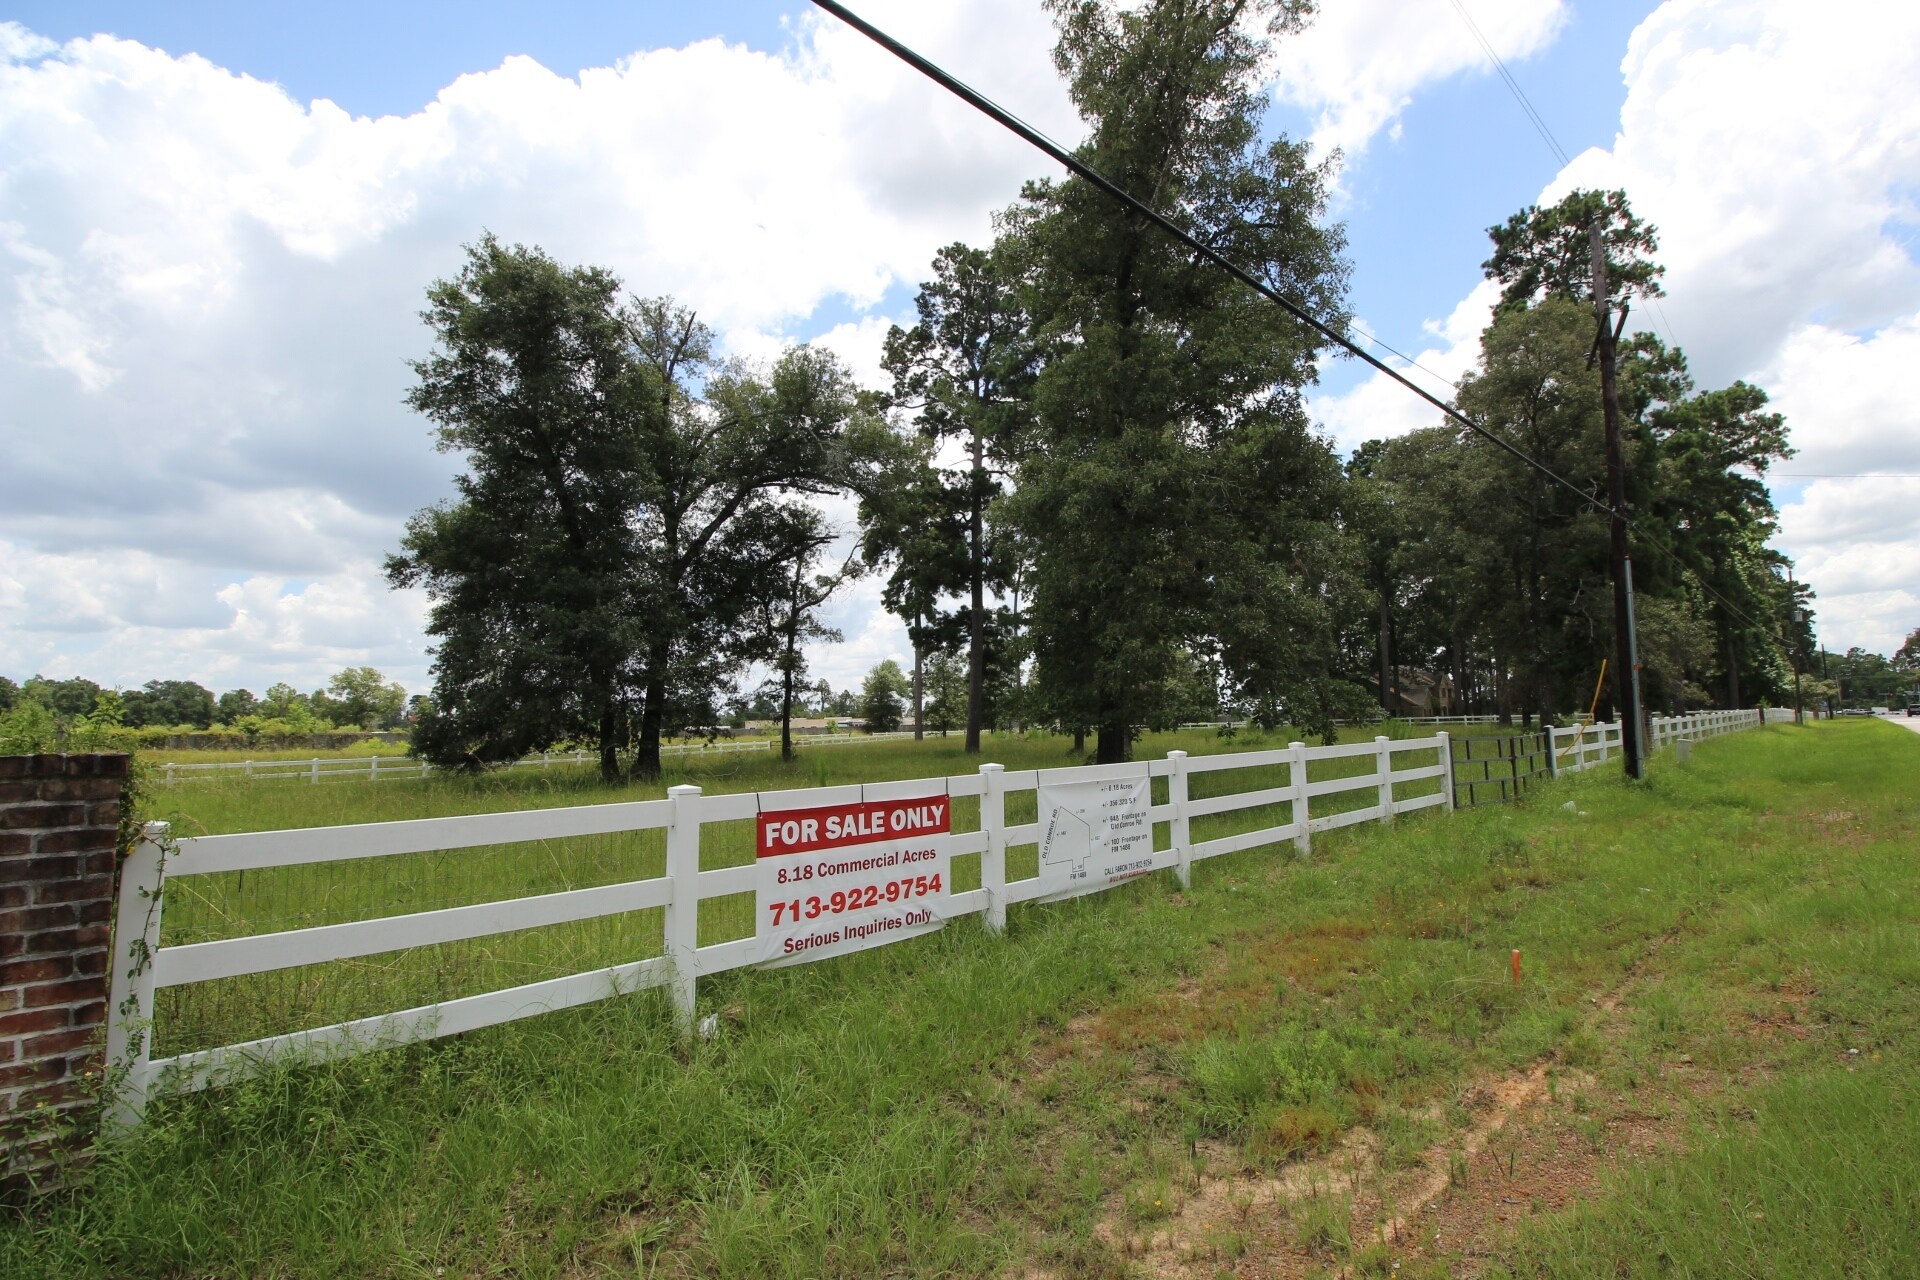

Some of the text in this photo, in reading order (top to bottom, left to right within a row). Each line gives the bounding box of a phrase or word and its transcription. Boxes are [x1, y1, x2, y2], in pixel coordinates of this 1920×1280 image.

[765, 804, 944, 848] FOR SALE ONLY
[1120, 821, 1135, 829] Conroe
[1121, 813, 1140, 821] Frontage
[1041, 845, 1049, 859] OLD
[1045, 819, 1056, 845] CONROE
[1111, 845, 1119, 853] FM
[1121, 835, 1141, 843] Frontage
[777, 848, 936, 884] 8.18 Commercial Acres
[1104, 866, 1115, 876] CALL
[769, 873, 942, 927] 713-922-9754
[783, 909, 932, 954] Serious Inquiries Only
